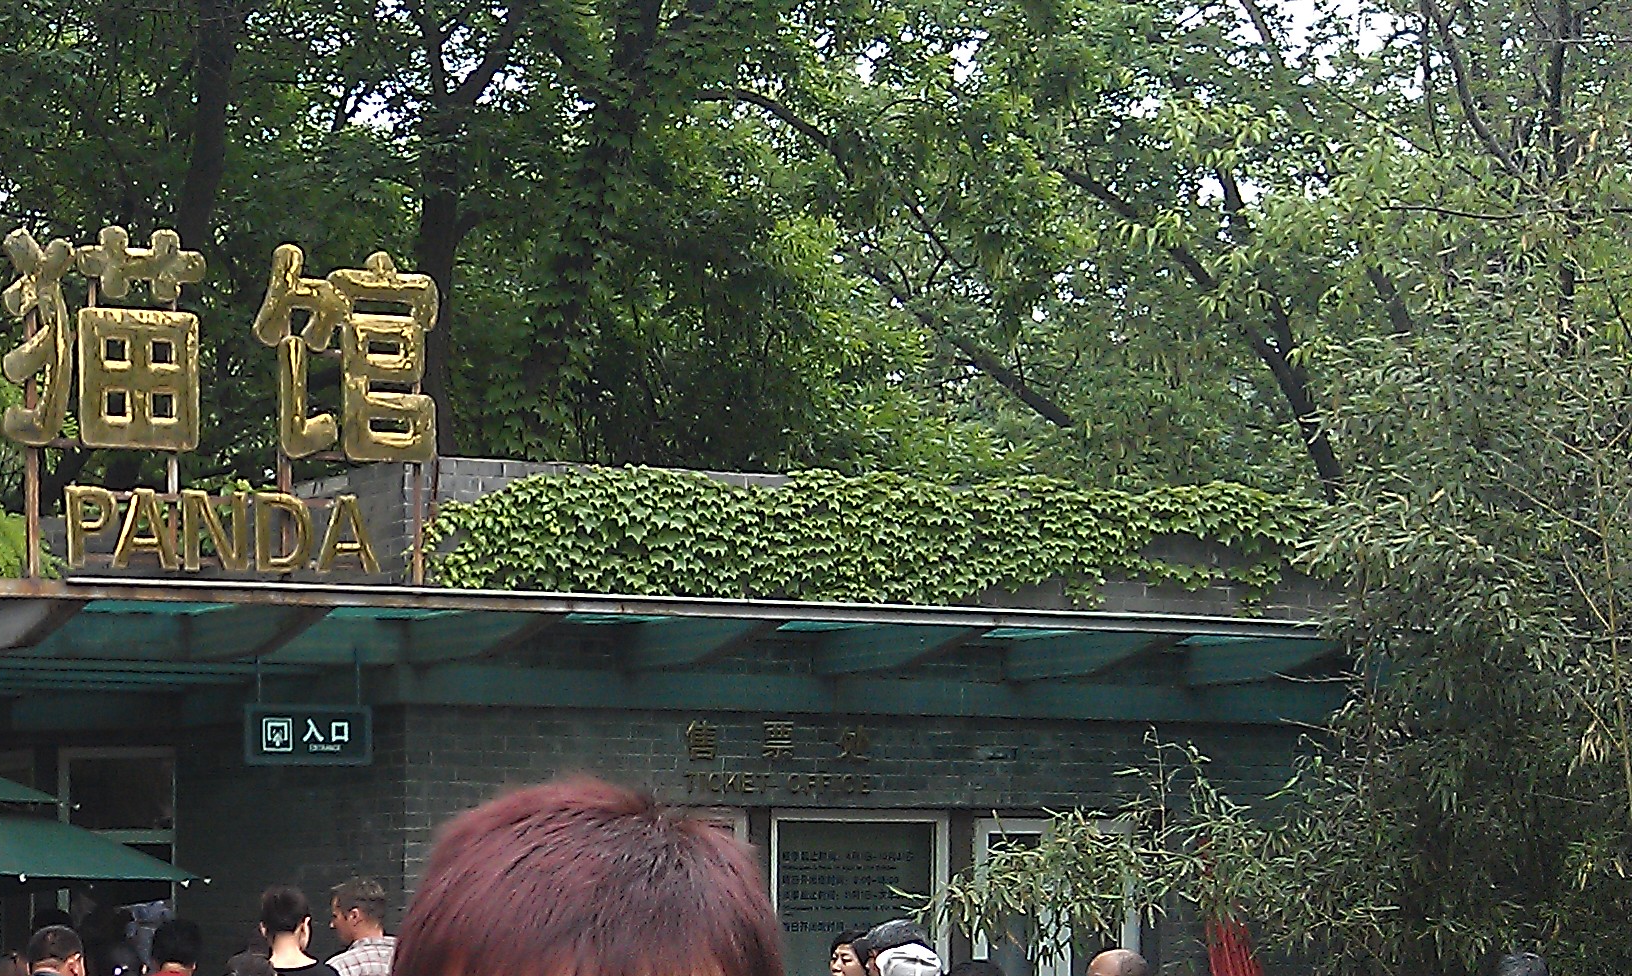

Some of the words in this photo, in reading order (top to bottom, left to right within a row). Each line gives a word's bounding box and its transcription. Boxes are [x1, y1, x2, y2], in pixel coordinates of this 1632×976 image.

[63, 484, 382, 576] PANDA
[302, 718, 349, 742] 入口
[685, 719, 870, 762] 售票处
[683, 772, 771, 795] TICKET
[786, 772, 872, 795] OFFICE
